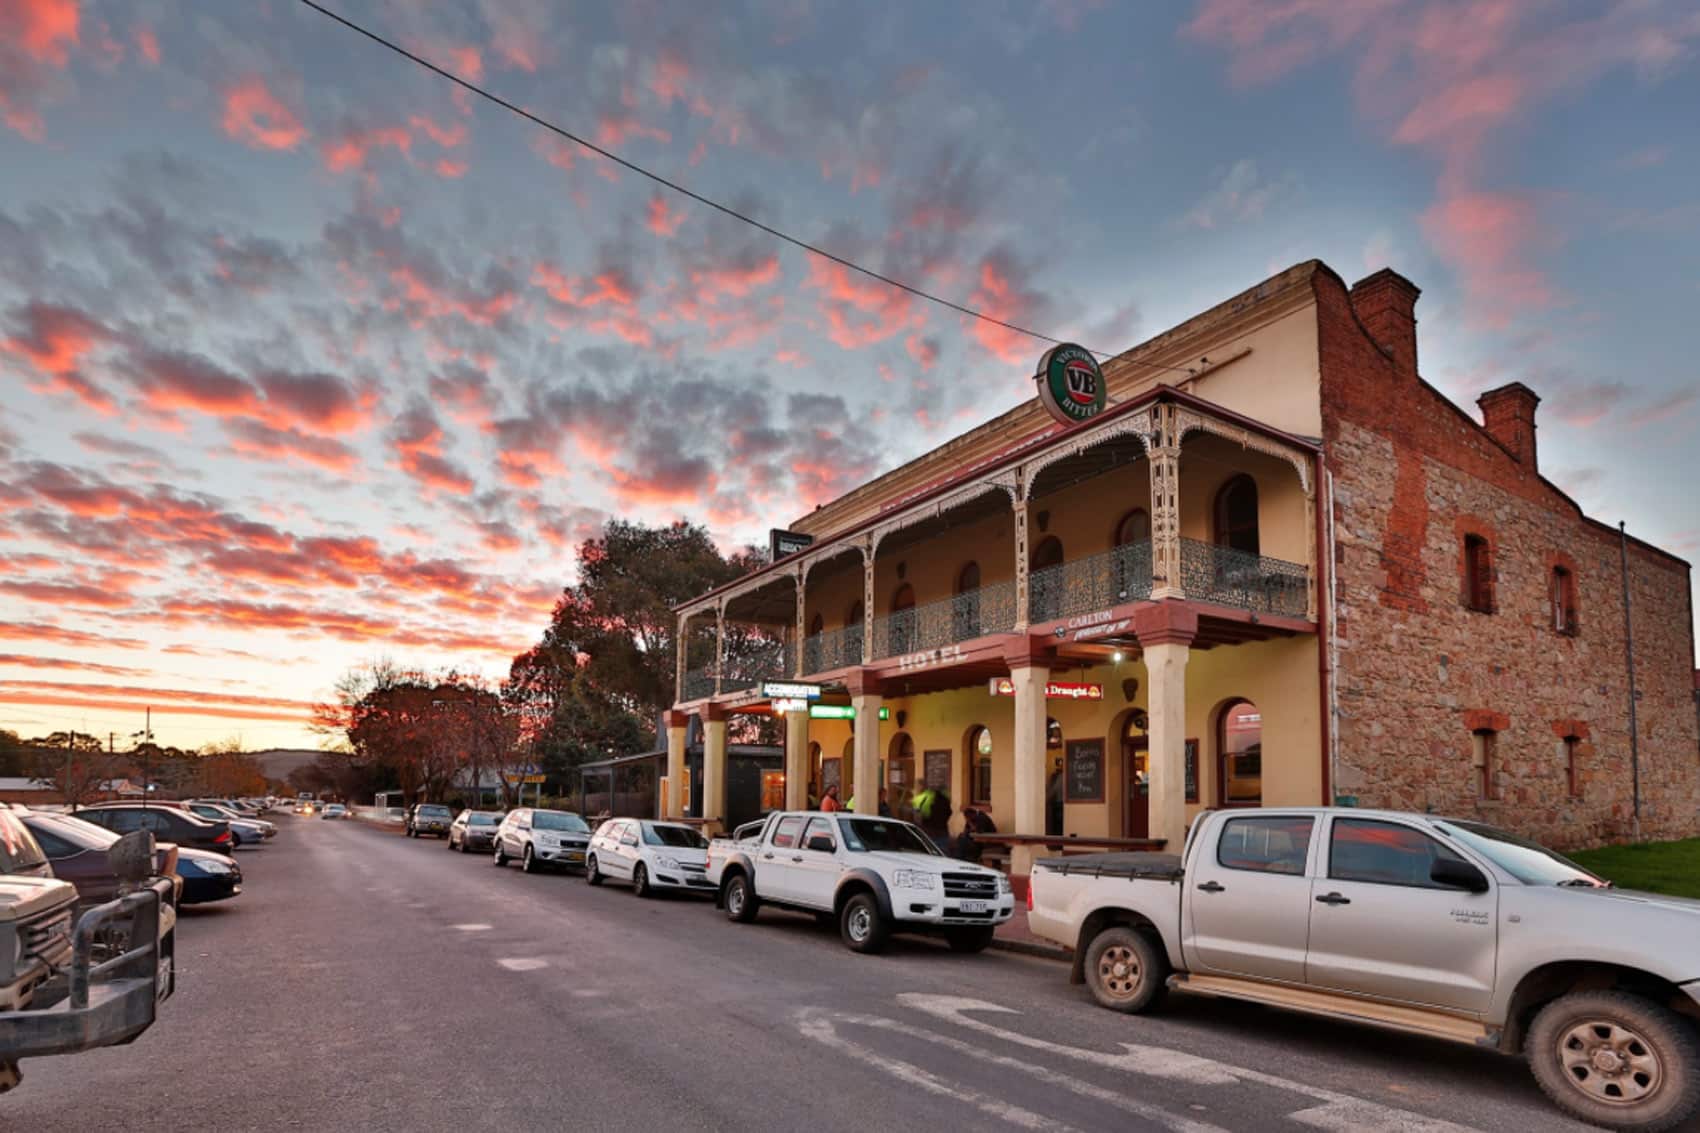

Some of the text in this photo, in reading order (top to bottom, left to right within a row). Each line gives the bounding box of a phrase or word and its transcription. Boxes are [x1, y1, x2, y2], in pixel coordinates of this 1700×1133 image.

[1068, 369, 1097, 395] VB
[1068, 609, 1113, 629] CARLTON
[899, 645, 968, 671] HOTEL
[1050, 685, 1088, 699] Draught
